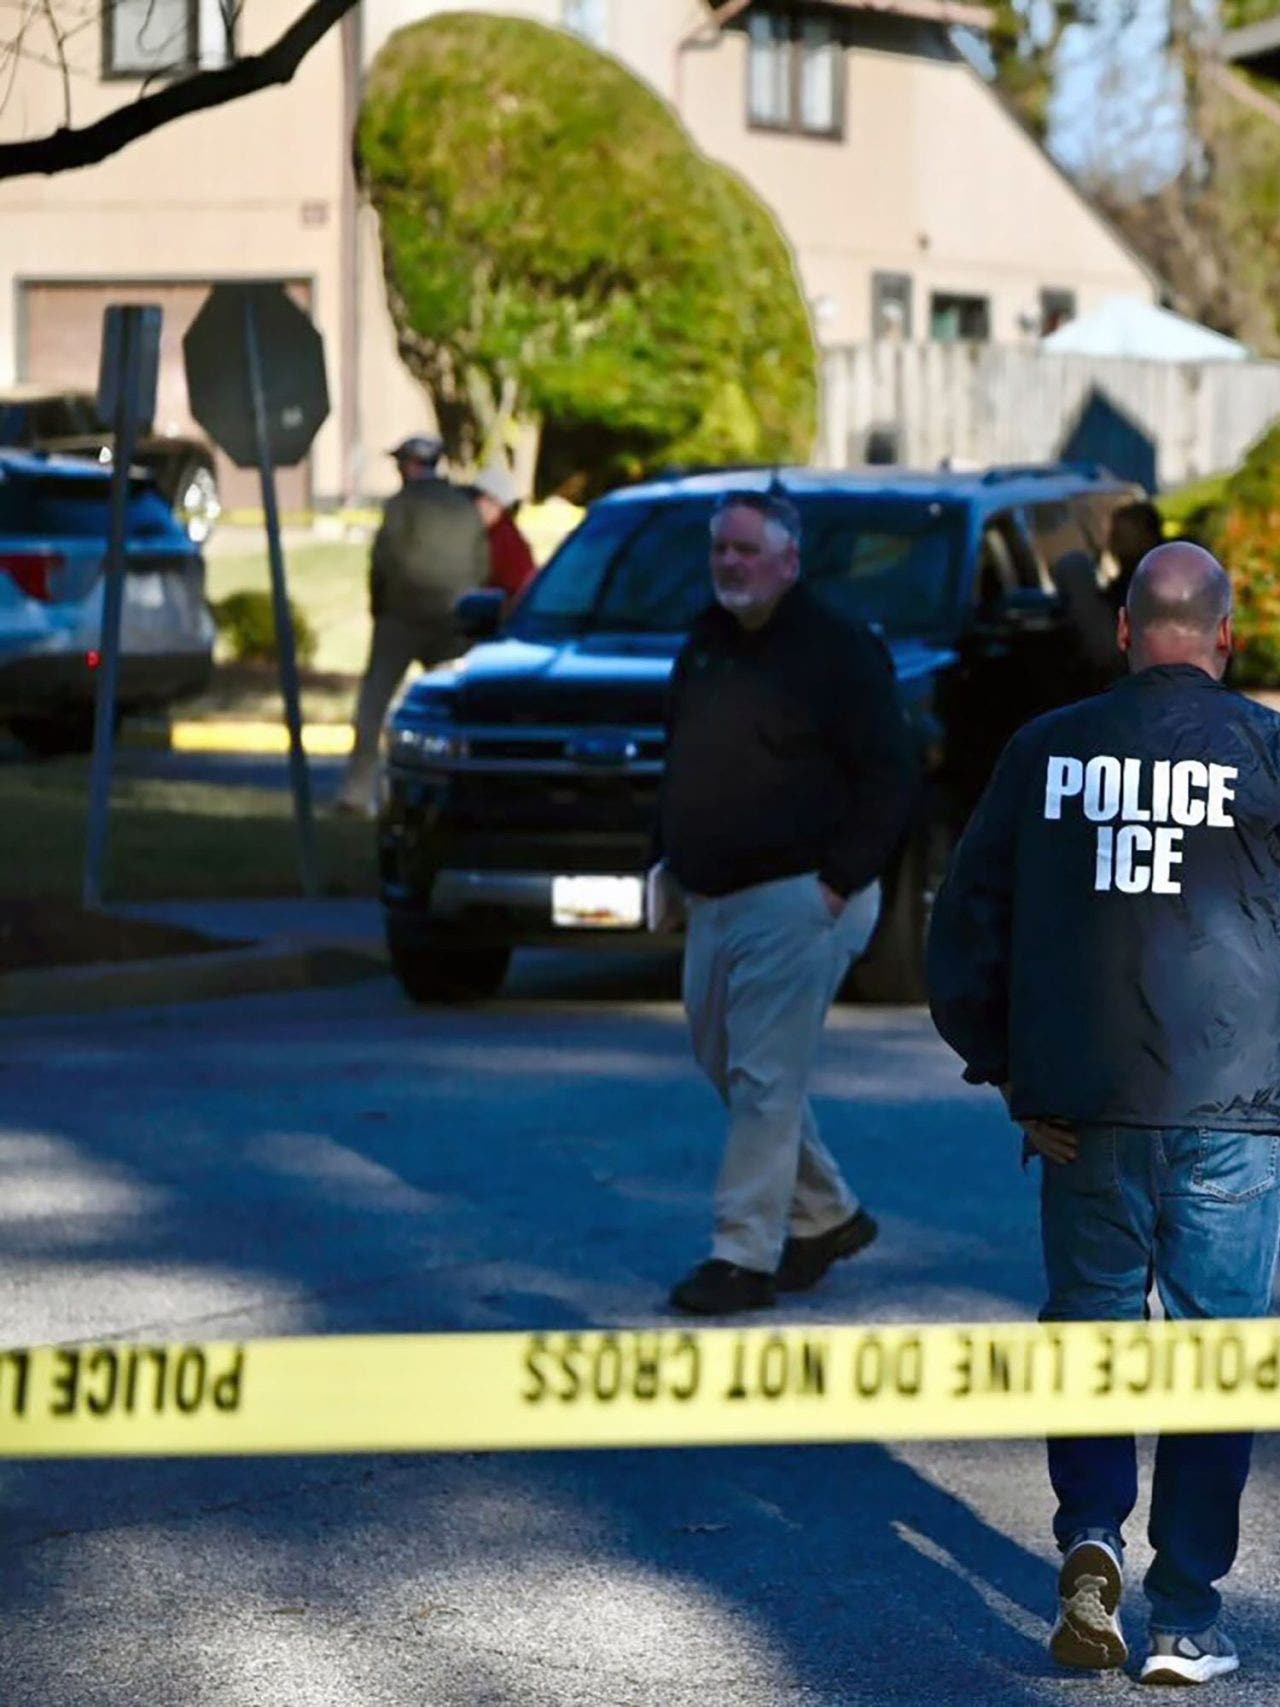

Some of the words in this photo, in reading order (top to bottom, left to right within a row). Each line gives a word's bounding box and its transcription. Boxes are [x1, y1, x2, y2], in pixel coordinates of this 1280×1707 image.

[1044, 755, 1239, 828] POLICE
[1094, 824, 1185, 895] ICE
[49, 1347, 244, 1415] POLICE
[523, 1331, 699, 1403] CROSS
[727, 1333, 829, 1400] NOT
[856, 1332, 922, 1398] DO
[955, 1334, 1063, 1397] LINE
